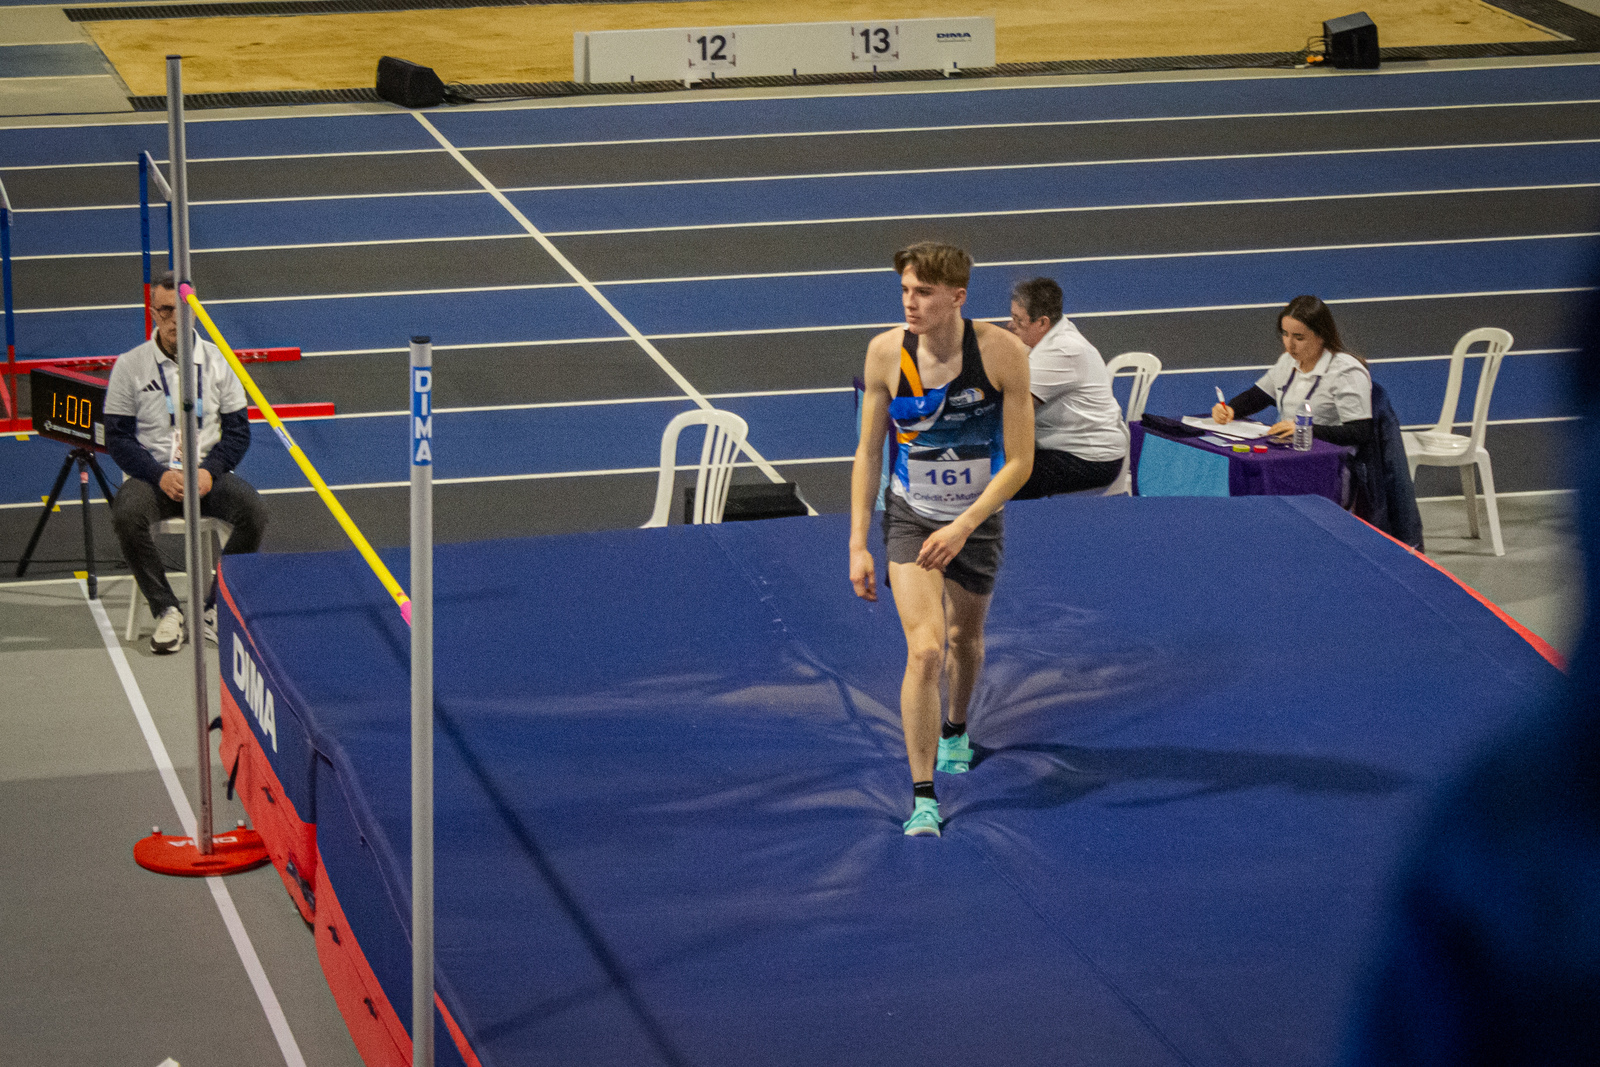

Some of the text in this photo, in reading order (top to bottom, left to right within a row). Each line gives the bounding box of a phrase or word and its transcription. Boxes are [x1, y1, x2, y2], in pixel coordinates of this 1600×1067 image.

[696, 34, 727, 61] 12
[860, 26, 891, 54] 13
[52, 392, 92, 429] 1:00
[414, 369, 433, 463] DIMA
[925, 467, 972, 486] 161
[913, 492, 943, 502] Crédit
[233, 631, 278, 754] DIMA
